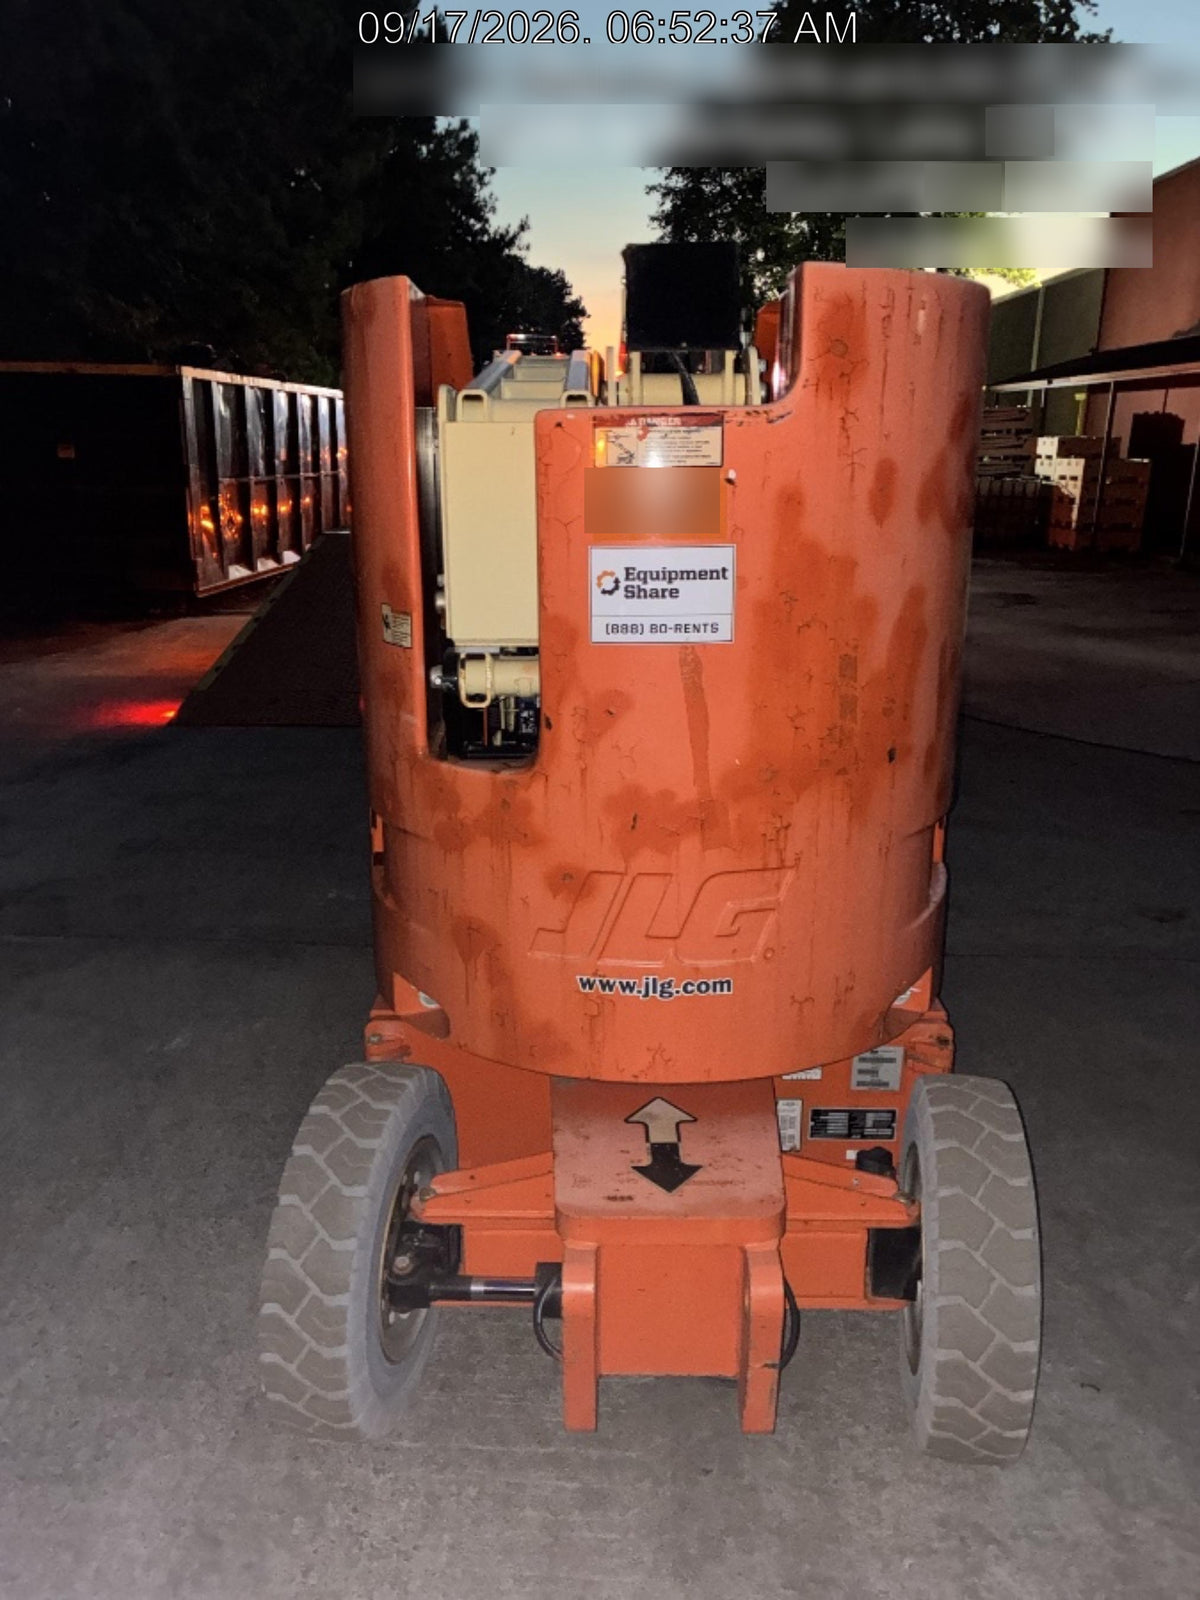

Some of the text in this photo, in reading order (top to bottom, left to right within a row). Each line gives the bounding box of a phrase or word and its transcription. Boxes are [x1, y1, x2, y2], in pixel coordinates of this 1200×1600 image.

[624, 567, 728, 585] Equipment
[624, 584, 680, 599] Share
[527, 866, 799, 968] JLG
[577, 975, 733, 999] www.jlg.com
